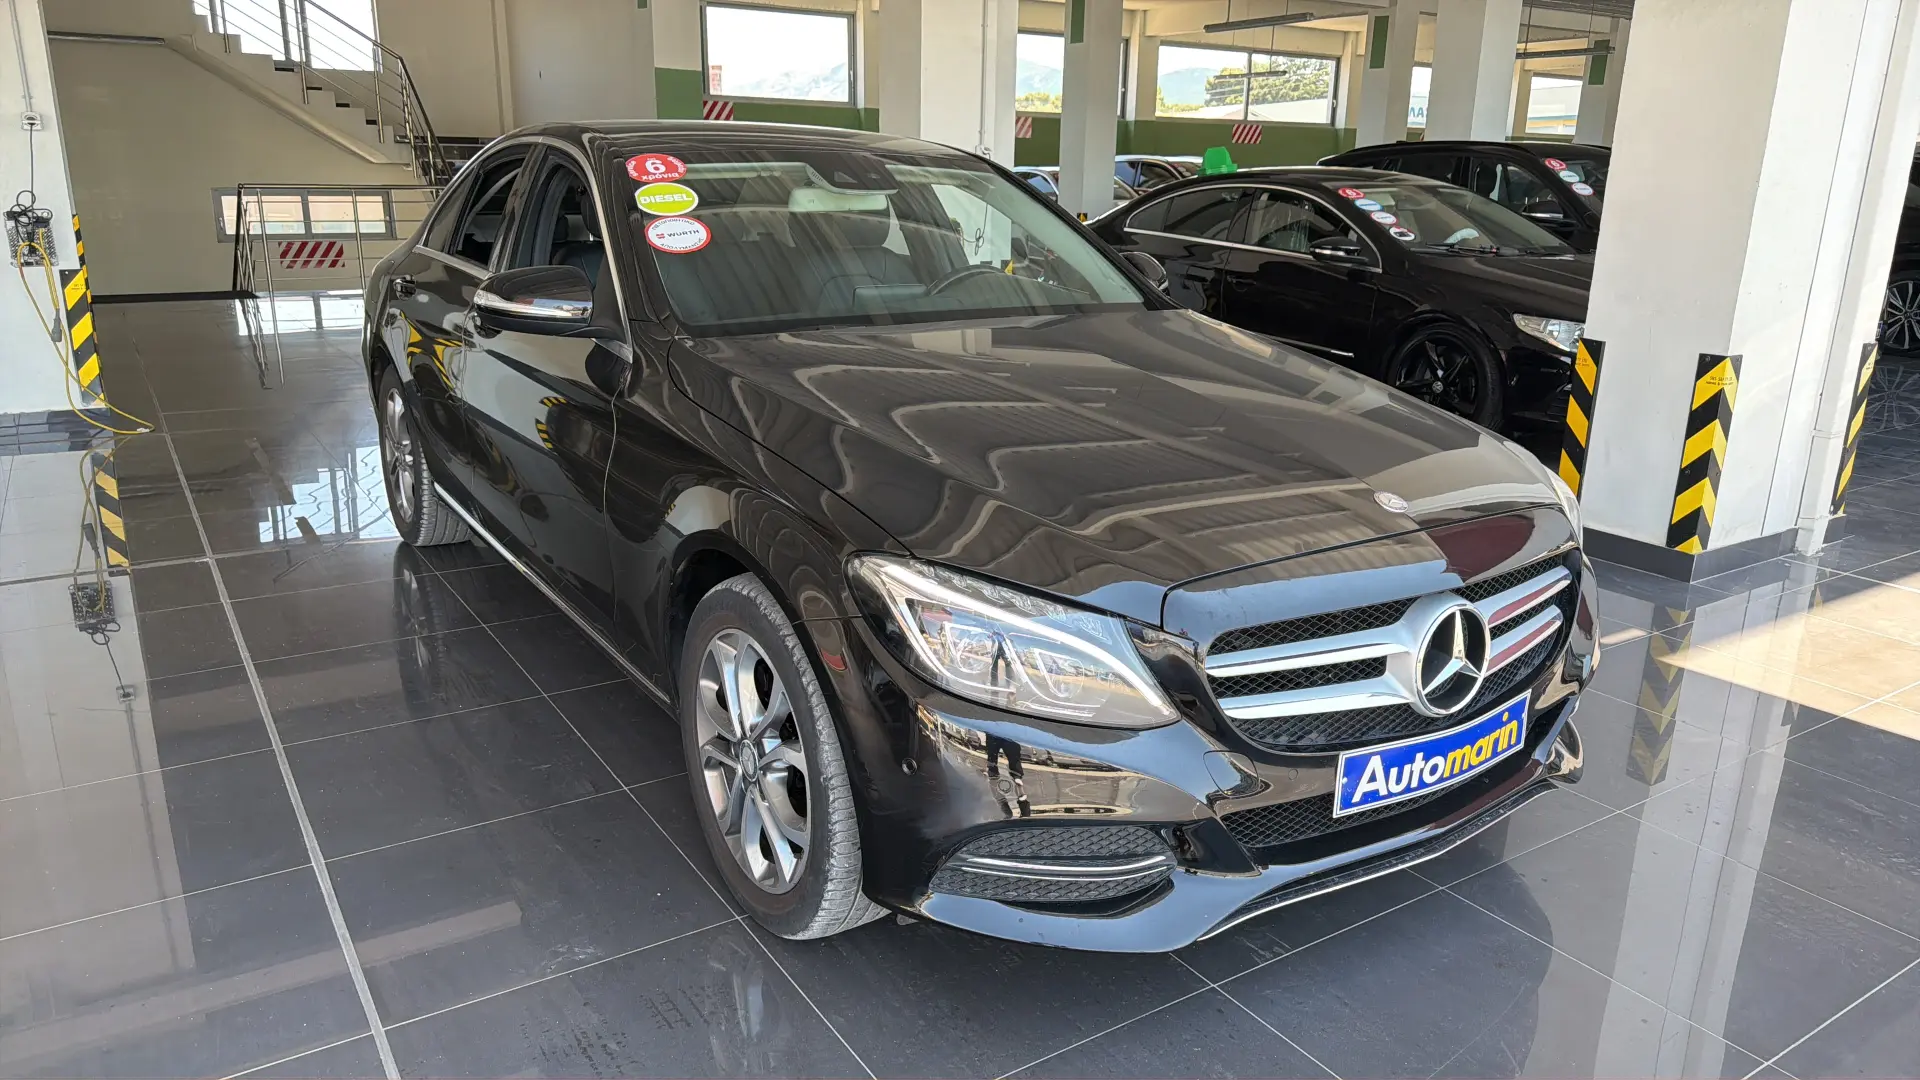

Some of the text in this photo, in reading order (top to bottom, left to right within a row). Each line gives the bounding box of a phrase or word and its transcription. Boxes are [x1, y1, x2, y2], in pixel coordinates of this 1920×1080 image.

[645, 159, 666, 174] 6
[641, 172, 679, 181] χρόνια
[640, 193, 693, 204] DIESEL
[1351, 711, 1519, 803] Automarin
